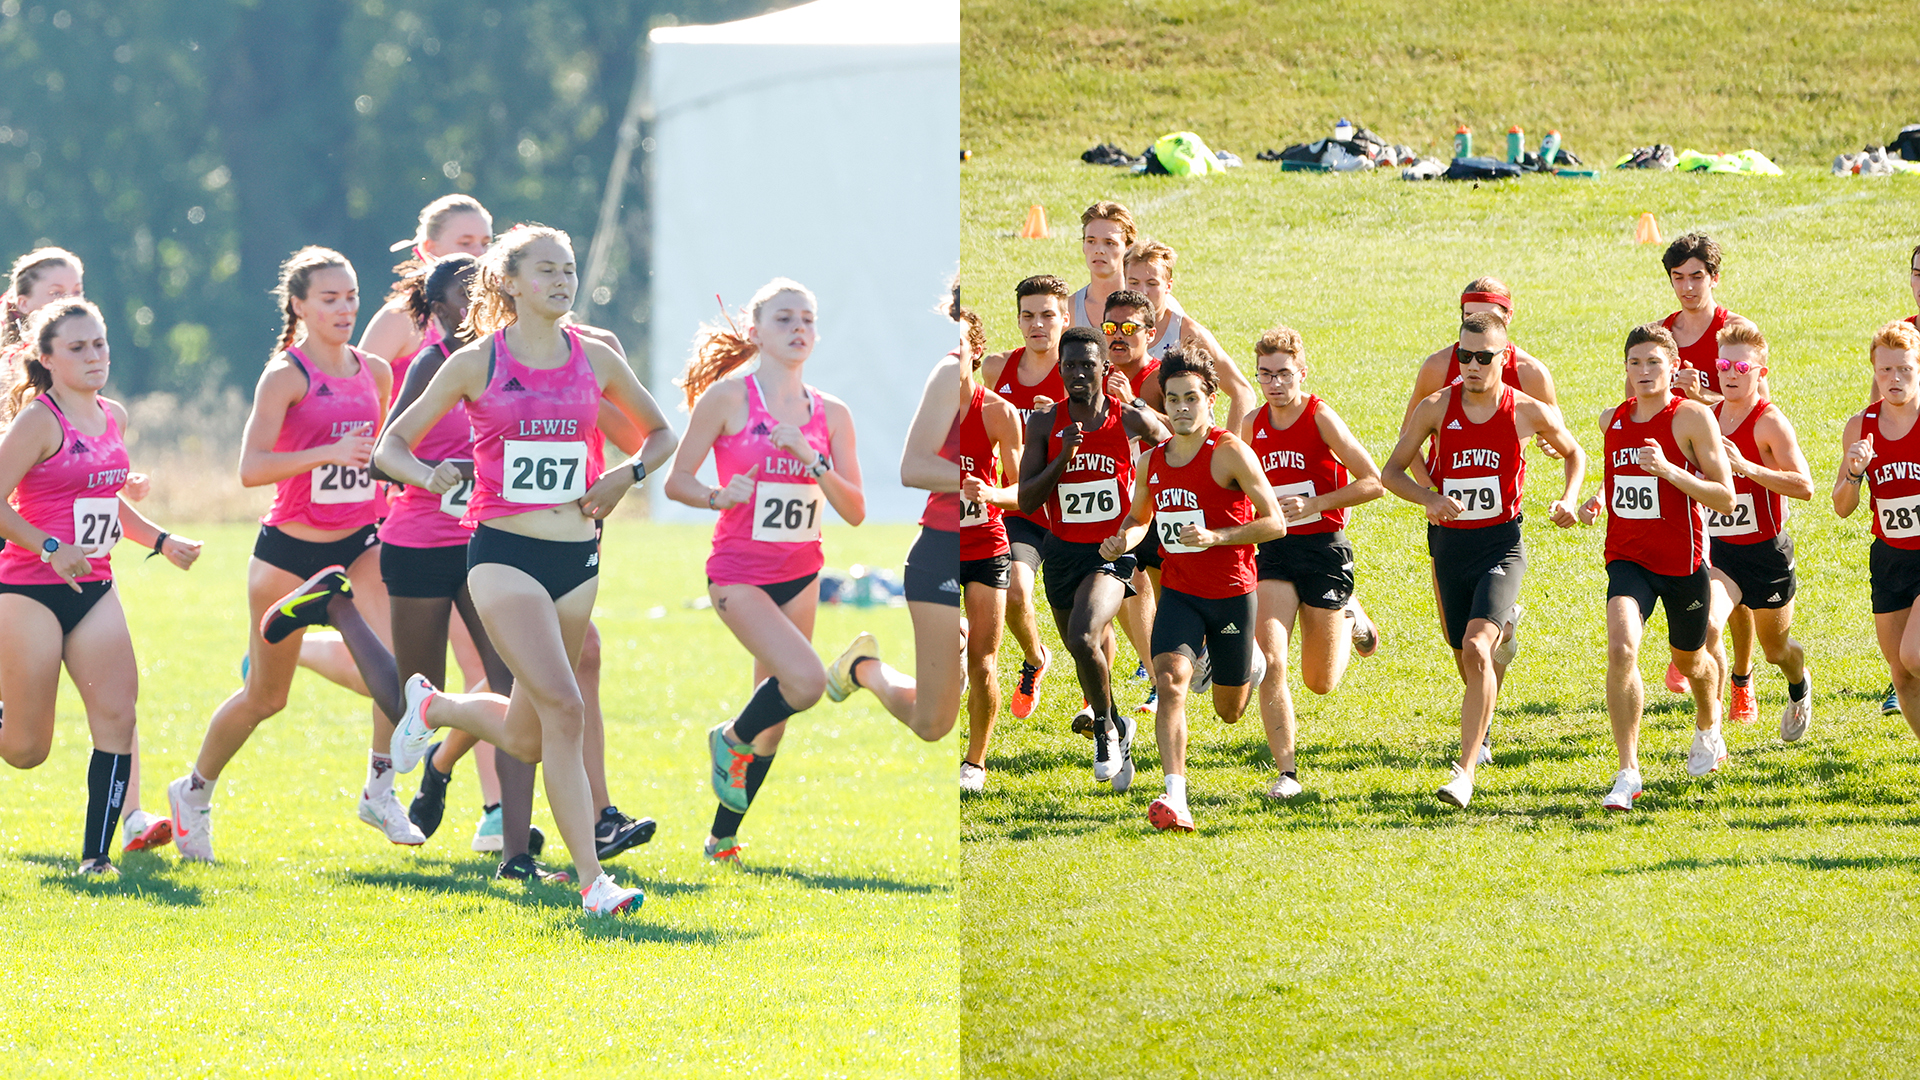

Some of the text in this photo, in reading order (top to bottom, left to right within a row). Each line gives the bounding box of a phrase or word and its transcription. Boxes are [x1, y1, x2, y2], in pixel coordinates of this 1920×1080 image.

[519, 419, 578, 437] LEWIS
[765, 456, 811, 478] LEW
[1066, 453, 1116, 475] LEWIS
[1262, 450, 1306, 473] LEWIS
[1452, 448, 1501, 470] LEWIS
[1612, 447, 1641, 468] LEW
[87, 468, 128, 489] LEWIS
[320, 464, 371, 491] 265
[512, 456, 580, 491] 267
[1064, 488, 1114, 515] 276
[1155, 488, 1199, 511] LEWIS
[1615, 485, 1653, 511] 296
[762, 497, 818, 530] 261
[1882, 504, 1920, 531] 281
[81, 513, 121, 545] 274
[1161, 521, 1195, 545] 29
